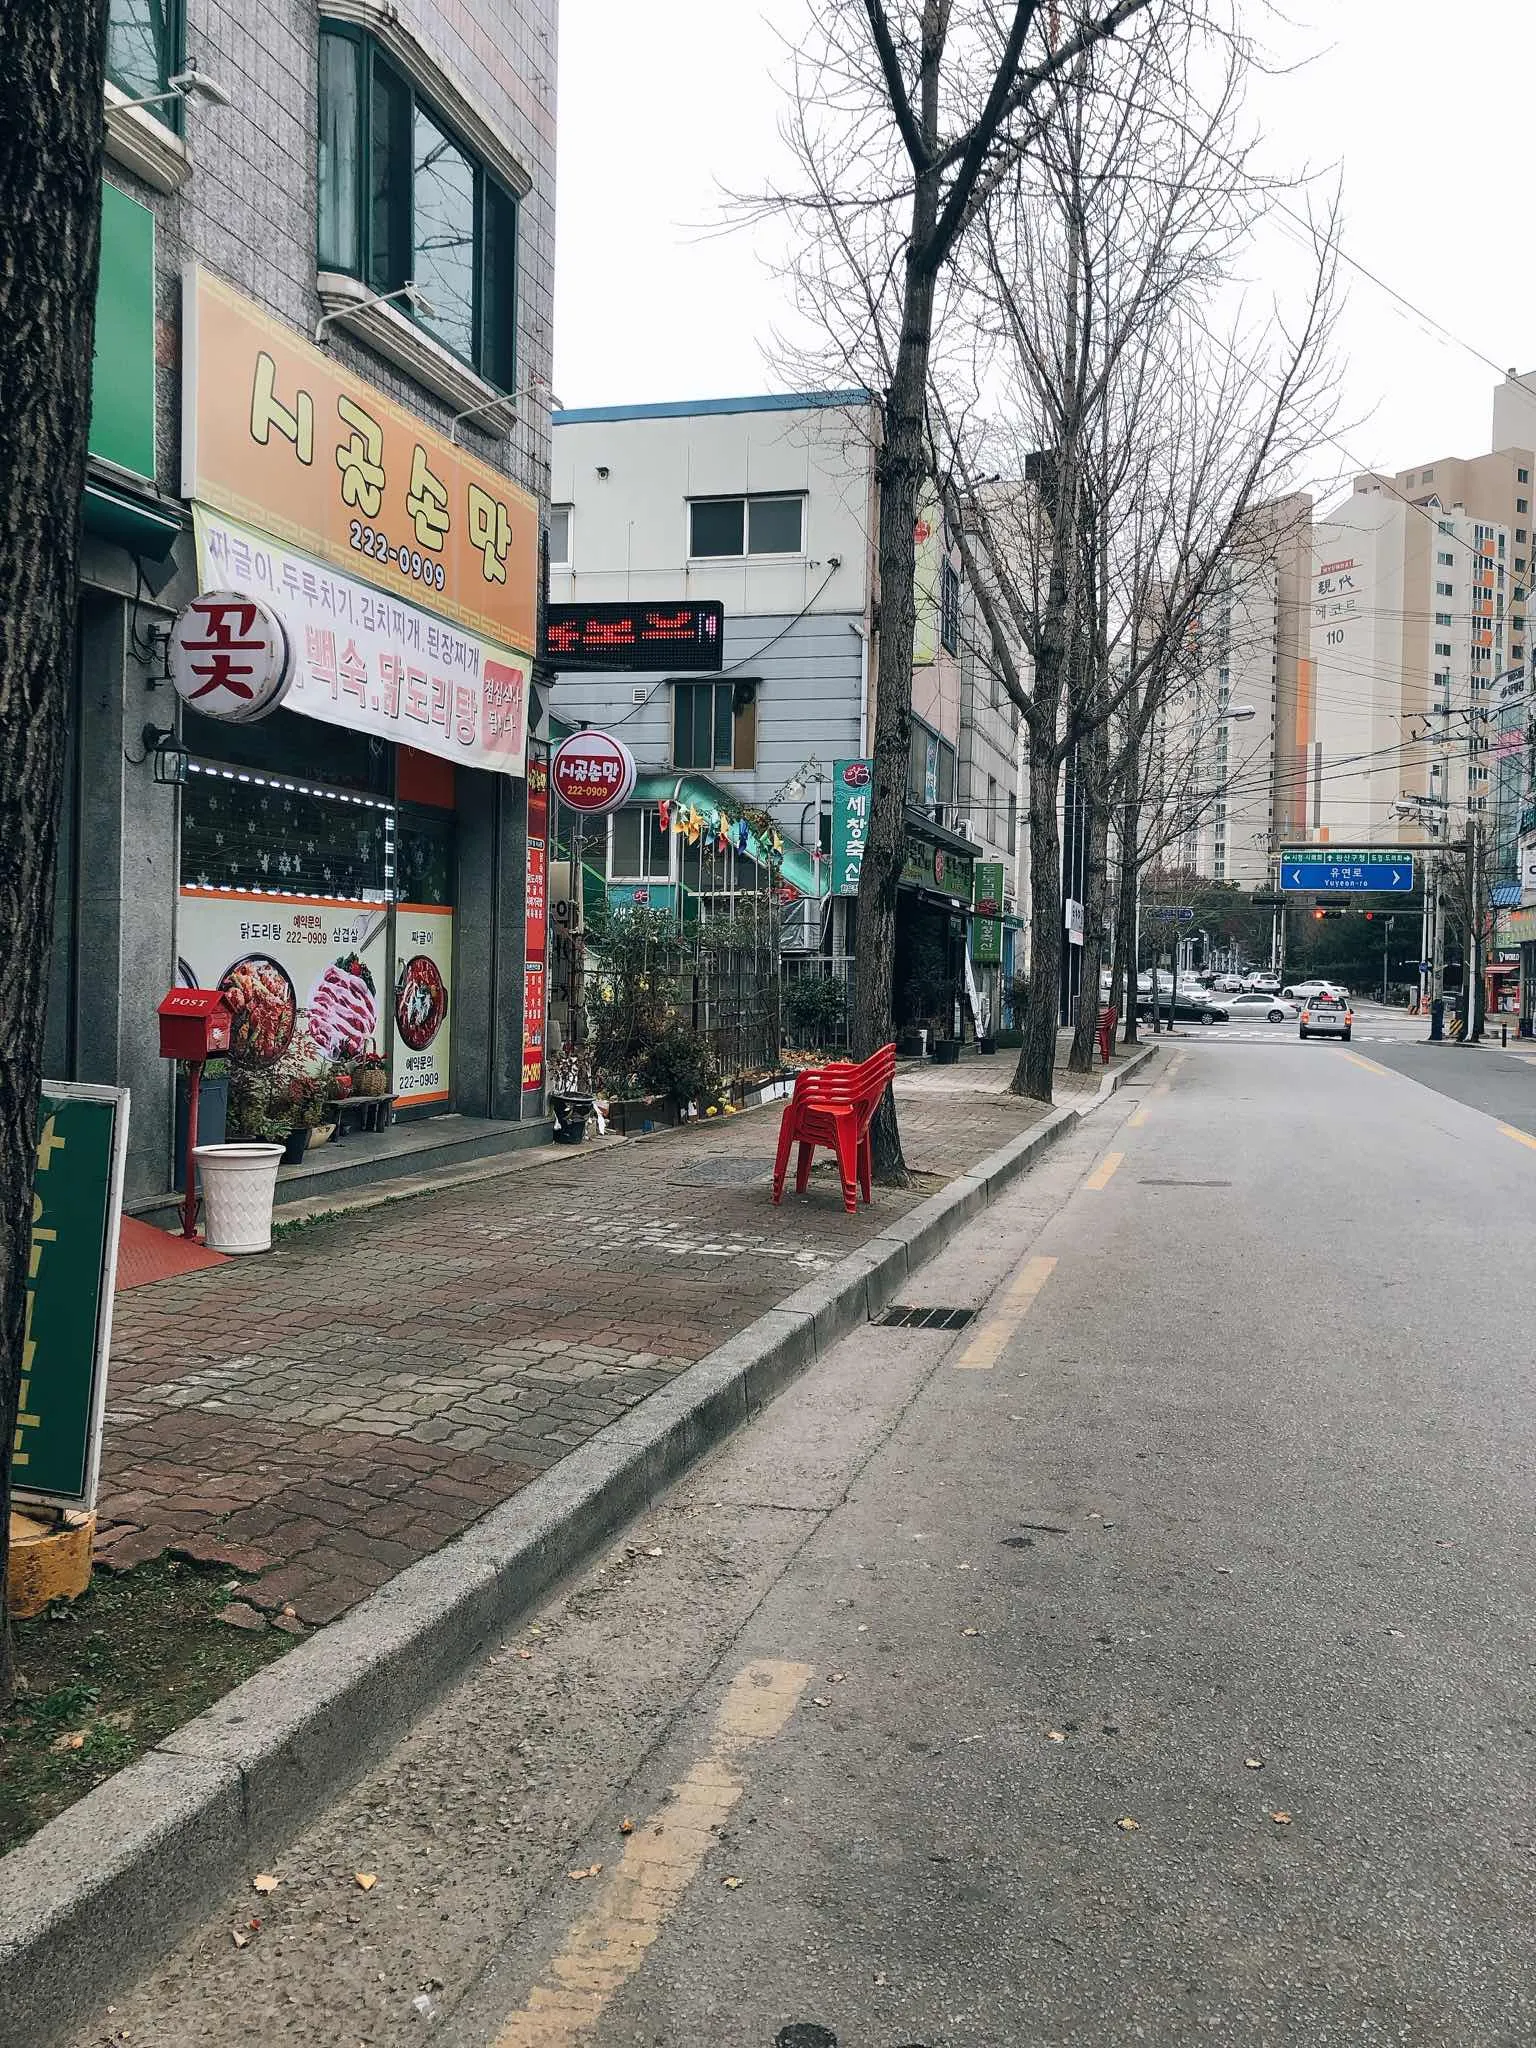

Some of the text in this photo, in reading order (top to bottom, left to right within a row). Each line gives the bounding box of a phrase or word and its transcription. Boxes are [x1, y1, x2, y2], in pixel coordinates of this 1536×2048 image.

[249, 350, 513, 585] 시골손맛
[348, 519, 447, 590] 222-0909
[1318, 574, 1355, 595] 現代
[1326, 629, 1344, 645] 110
[180, 603, 265, 700] 꽃
[560, 759, 619, 784] 시골손맛
[567, 785, 608, 797] 222-0909
[1330, 867, 1363, 879] 유연로
[1324, 879, 1368, 888] Yuyeon-ro
[293, 915, 322, 929] 예약문의
[240, 922, 282, 942] 닭도리탕
[286, 931, 327, 945] 222-0909
[332, 926, 359, 944] 삼겹살
[411, 931, 434, 945] 짜글이
[171, 996, 209, 1008] POST
[406, 1055, 434, 1070] 예약문의
[399, 1071, 439, 1090] 222-0909
